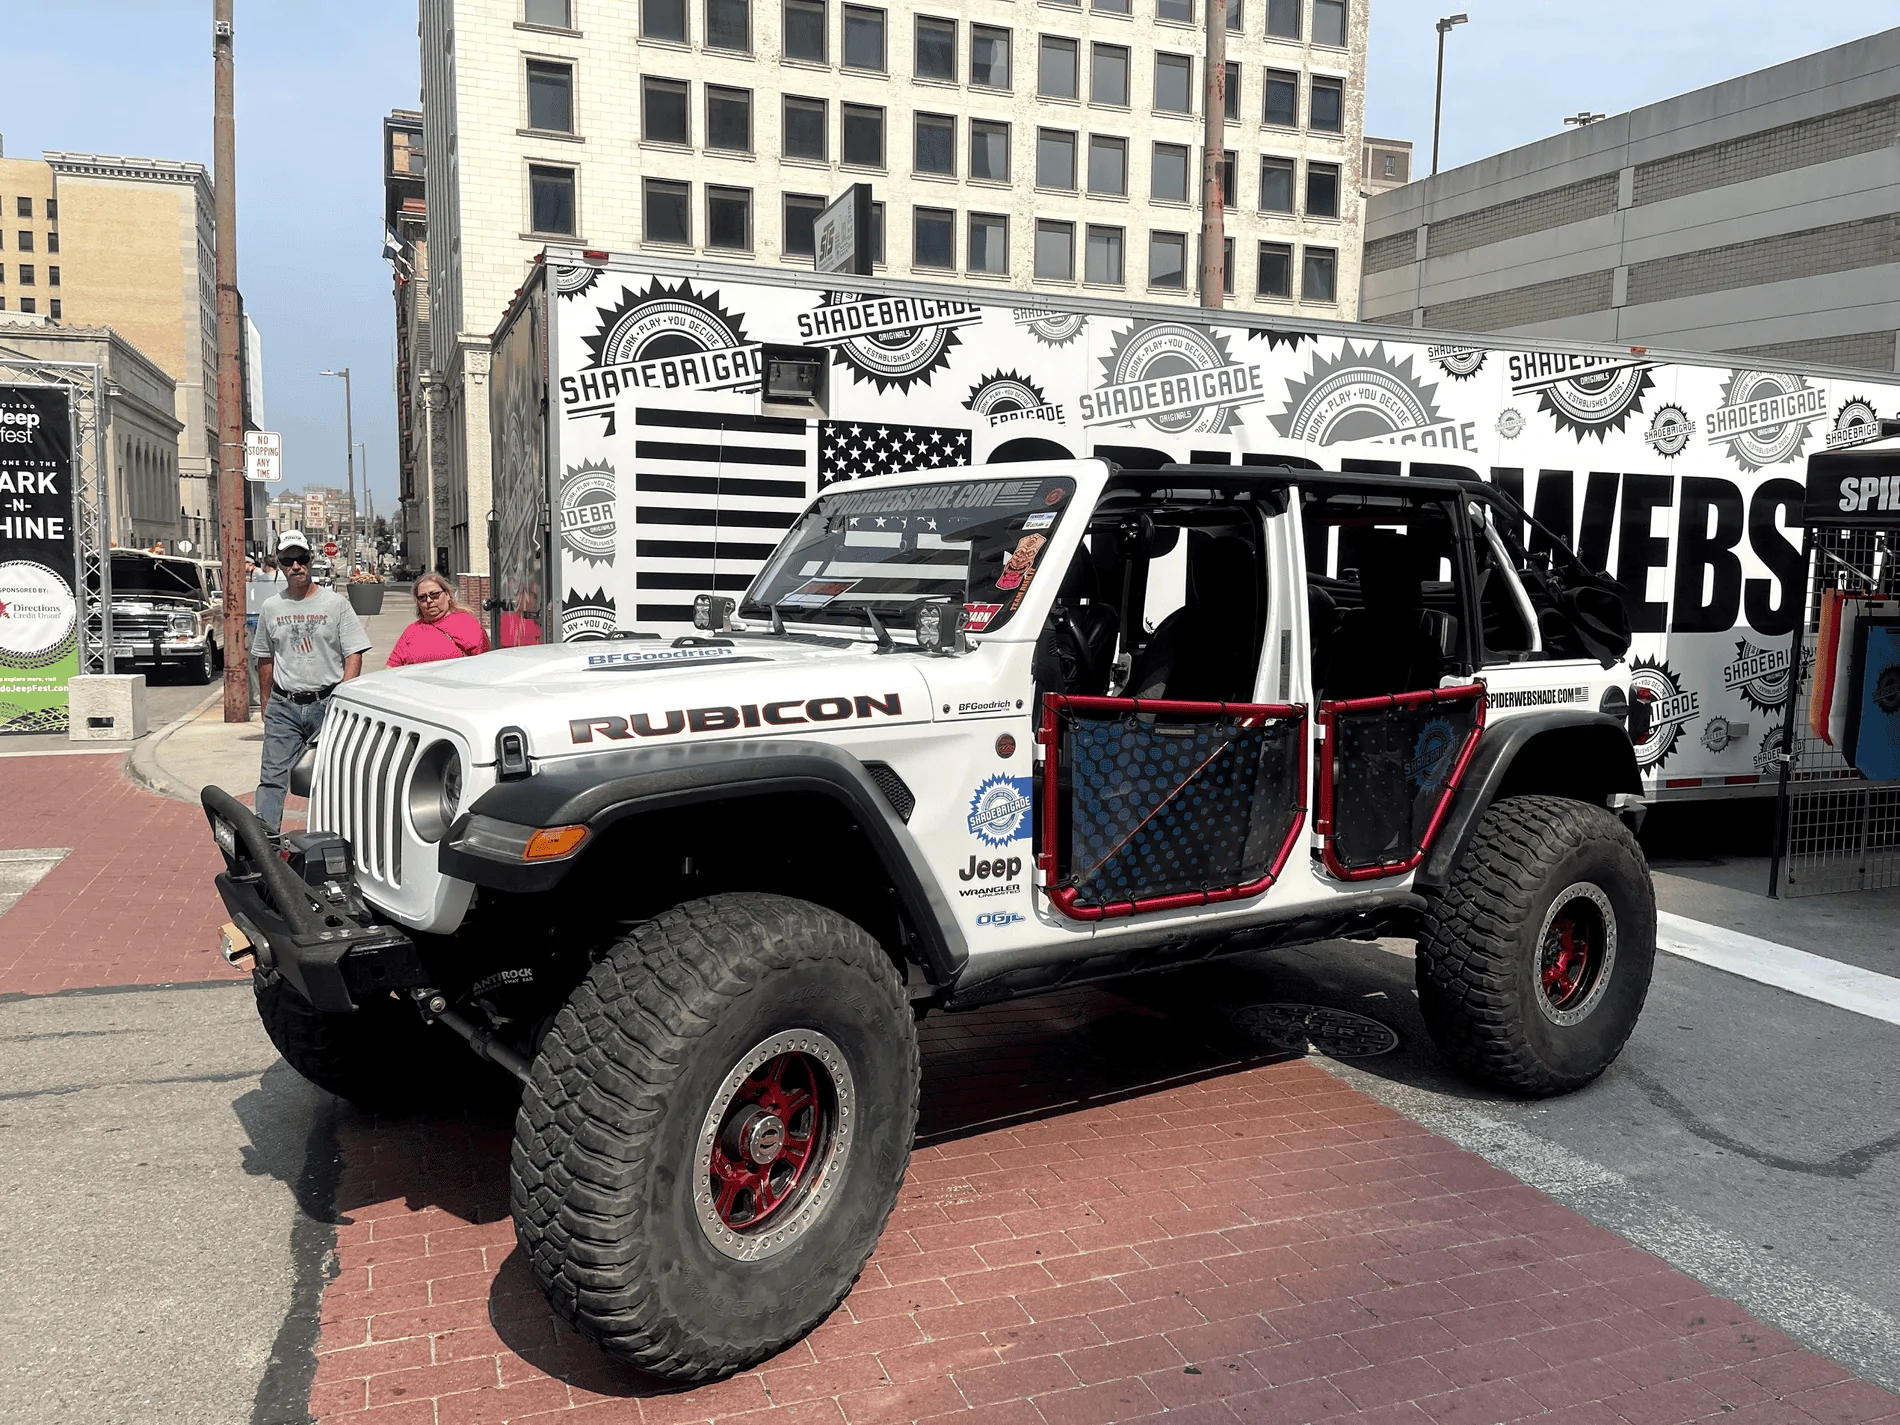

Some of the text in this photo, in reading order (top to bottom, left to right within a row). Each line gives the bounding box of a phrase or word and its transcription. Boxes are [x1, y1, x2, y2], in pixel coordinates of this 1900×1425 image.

[620, 315, 720, 360] WORK PLAY YOU DECIDE
[878, 329, 911, 342] ORIGINALS
[866, 340, 927, 363] ESTABLISHED 2005
[1128, 338, 1209, 379] WORK PLAY YOU DECIDE
[560, 349, 762, 405] SHADEBRIGAD
[1580, 372, 1610, 385] ORIGINALS
[1079, 364, 1263, 421] SHADEBRIGADE
[1568, 383, 1624, 408] ESTABLISHED 2005
[1738, 382, 1750, 400] WORK
[1159, 410, 1192, 423] ORIGINALS
[1306, 388, 1410, 443] WORK PLAY YOU DECIDE
[1706, 388, 1827, 435] SHADEBRIGADE
[1644, 420, 1696, 441] SHADEBRIGADE
[1826, 423, 1877, 445] SHADEBRIGA
[257, 436, 269, 445] NO
[1748, 440, 1778, 455] ESTABLISHED
[248, 446, 279, 457] STOPPING
[256, 458, 270, 468] ANY
[256, 469, 270, 478] TIME
[566, 492, 576, 507] WORK
[577, 480, 591, 492] PLAY
[593, 479, 605, 487] YOU
[823, 482, 1004, 517] SPIDERWEBSHADE.COM
[581, 536, 615, 547] ESTABLISHED
[13, 604, 60, 612] Directions
[276, 614, 328, 627] BASS PRO SHOPS
[584, 619, 600, 628] YOU
[588, 648, 732, 665] BFGoodrich
[958, 700, 1010, 711] BFGoodrich
[569, 693, 901, 744] RUBICON
[969, 796, 1031, 827] SHADEBRIGADE
[958, 855, 1022, 882] Jeep
[959, 884, 1021, 897] WRANGLER
[978, 889, 1021, 898] UNLIMITED
[1266, 1017, 1356, 1036] WATER
